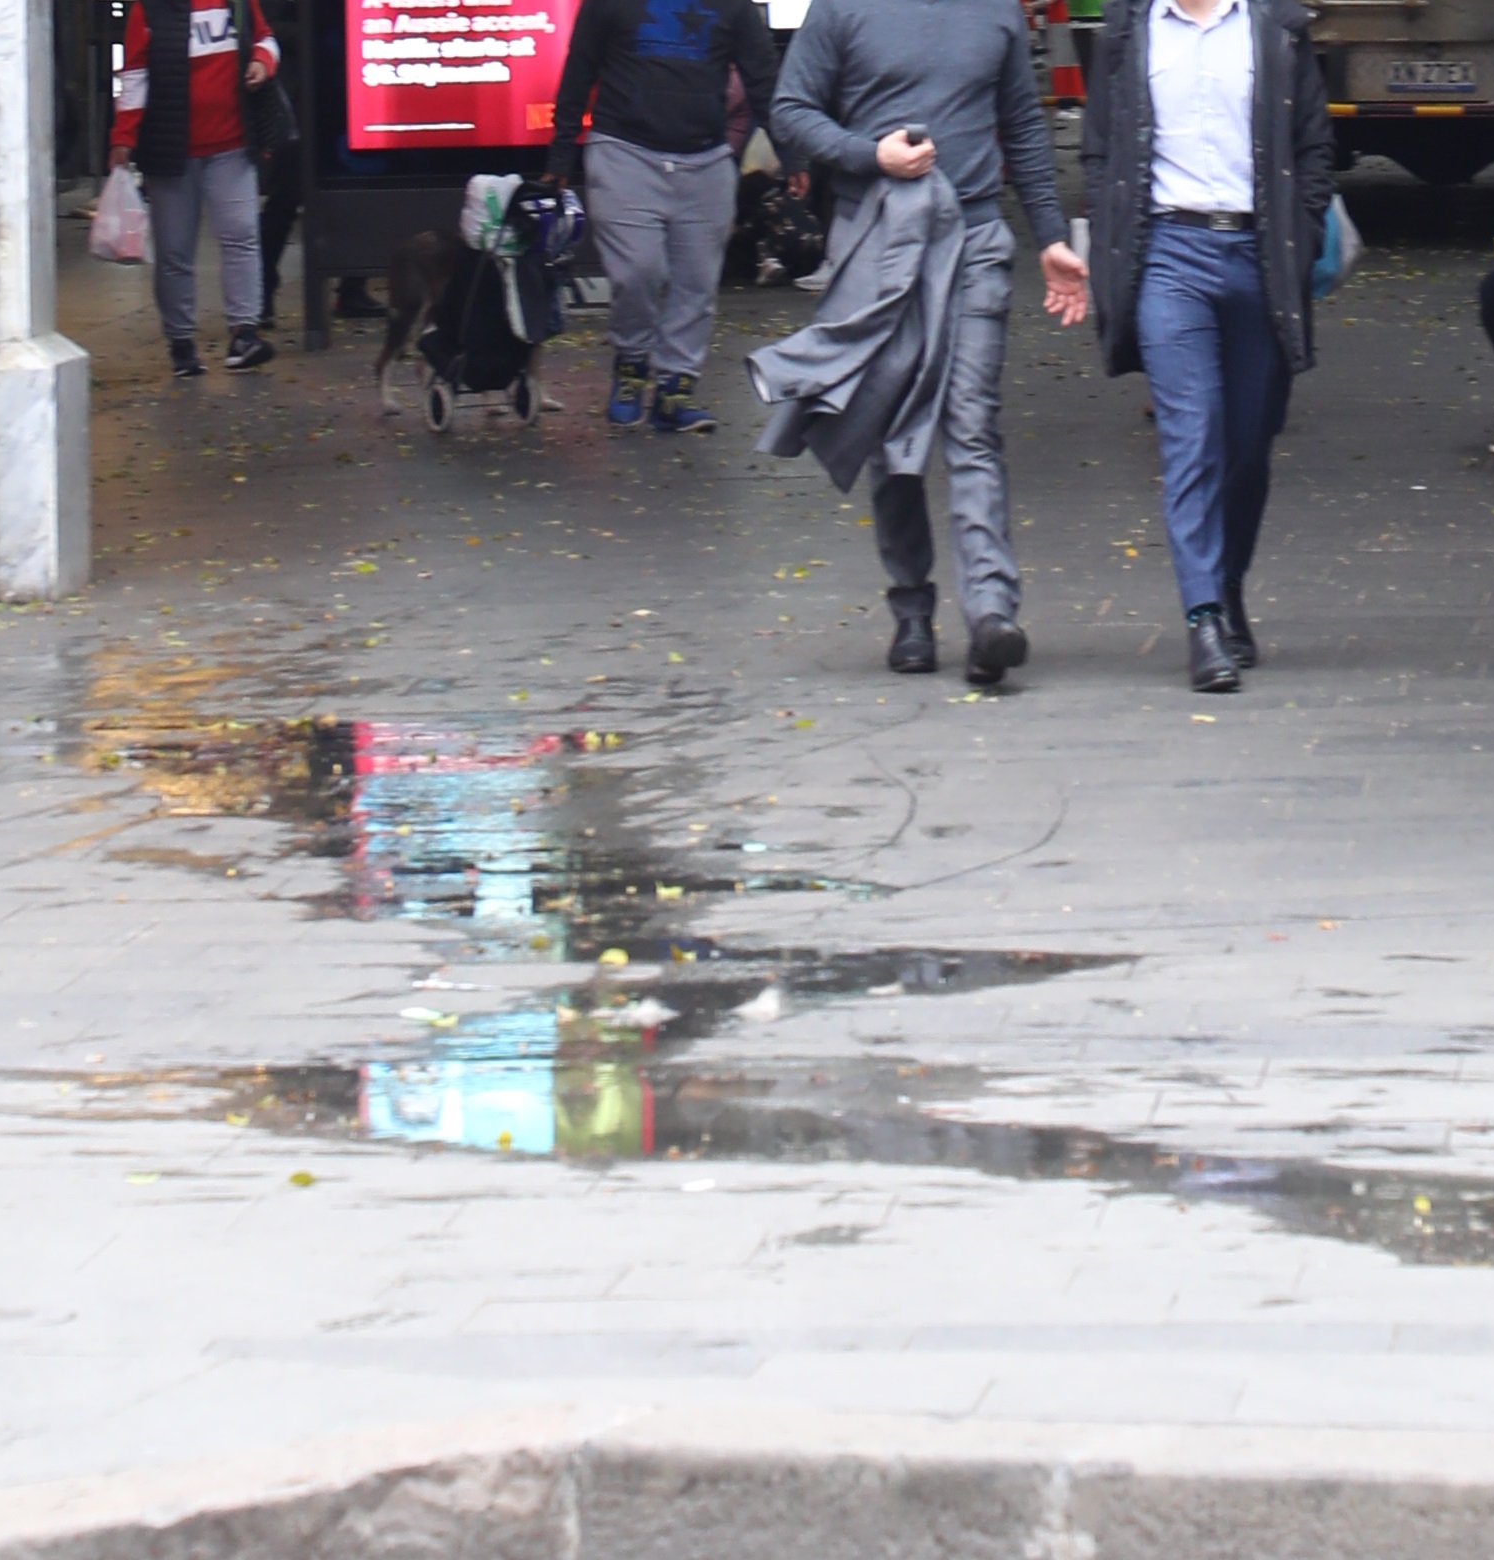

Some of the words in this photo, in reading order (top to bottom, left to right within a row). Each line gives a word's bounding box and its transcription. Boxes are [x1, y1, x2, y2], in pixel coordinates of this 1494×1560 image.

[362, 18, 392, 33] an
[394, 13, 471, 33] Aussie
[472, 12, 555, 33] accent,
